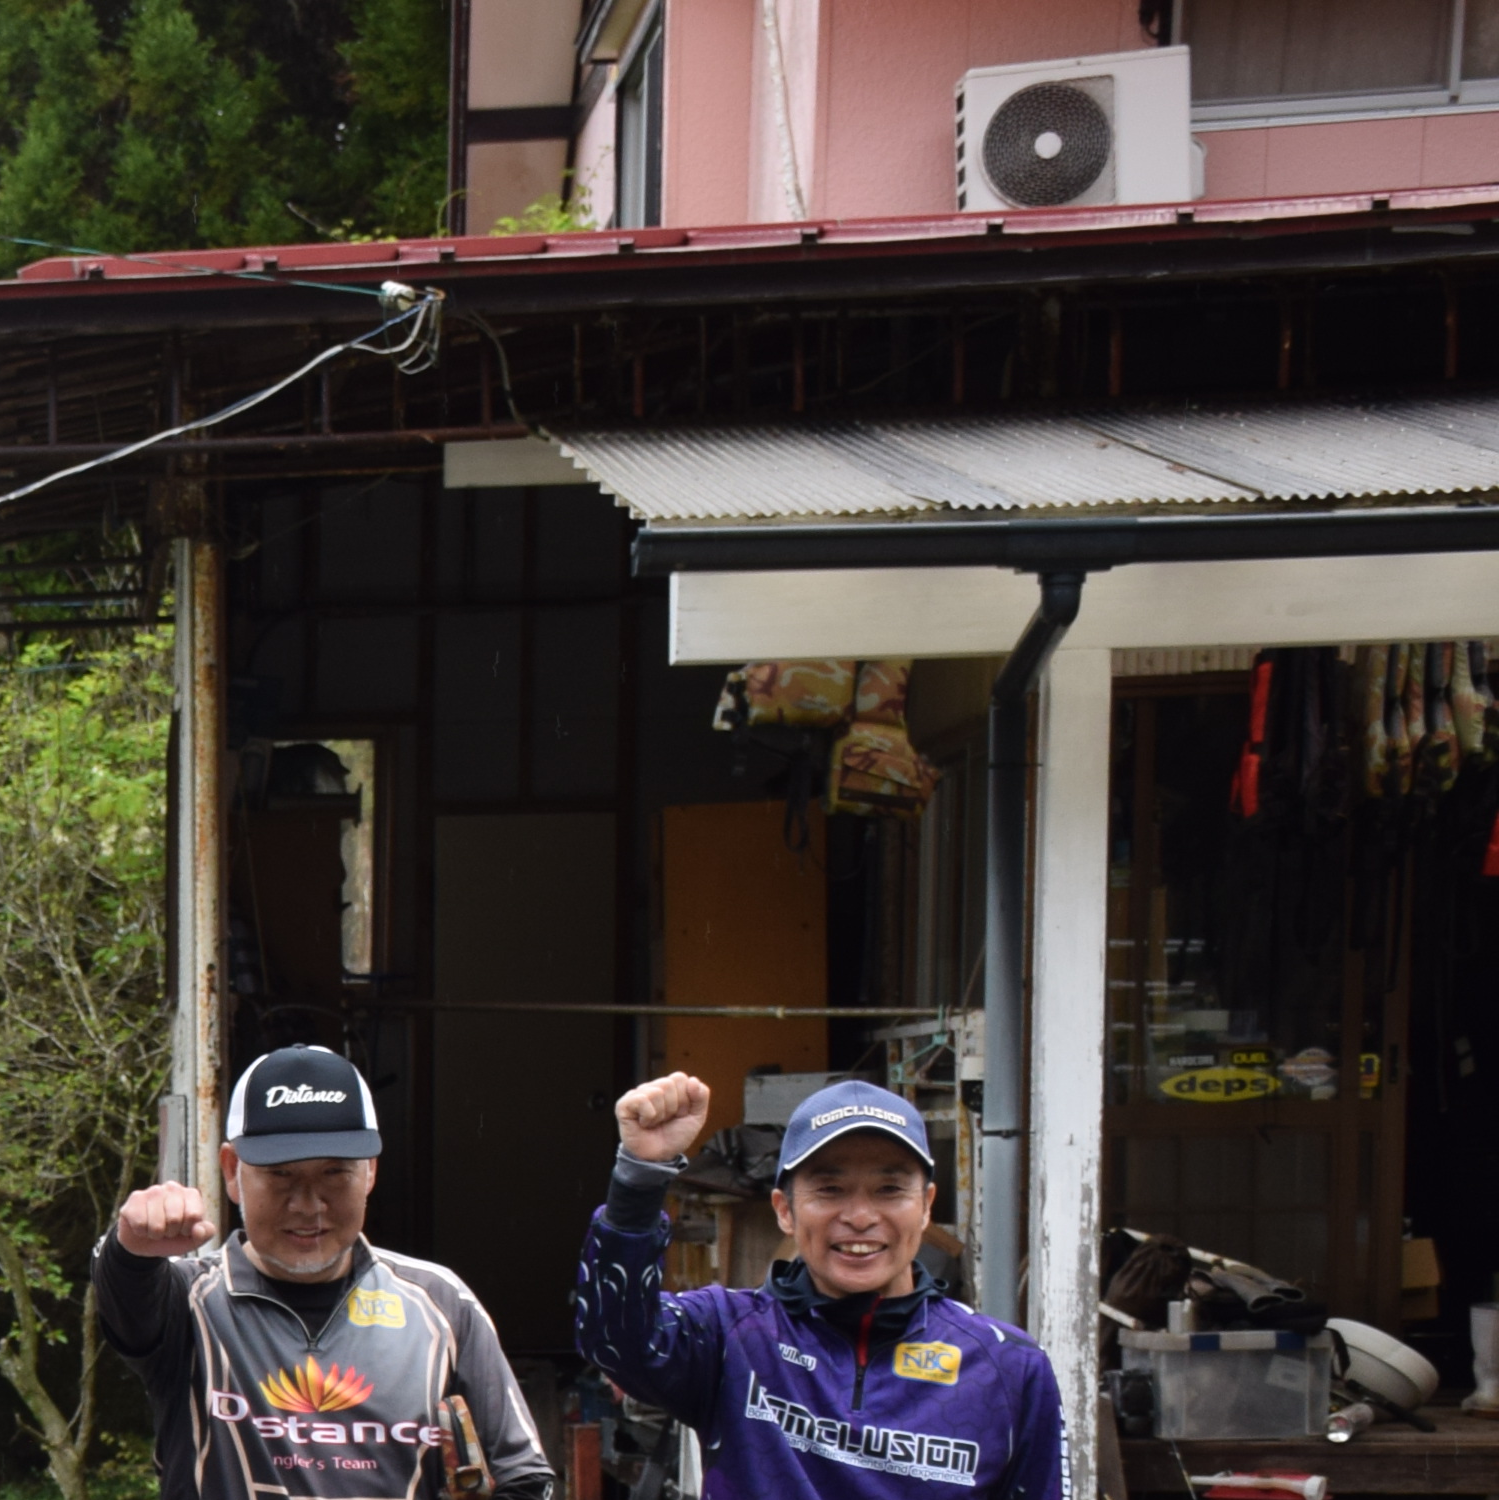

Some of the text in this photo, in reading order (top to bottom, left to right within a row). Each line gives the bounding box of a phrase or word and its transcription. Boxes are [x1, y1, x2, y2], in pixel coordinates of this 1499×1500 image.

[265, 1084, 347, 1109] Distance
[1174, 1077, 1269, 1097] deps
[903, 1349, 953, 1373] NBC
[211, 1390, 441, 1447] Dstance
[274, 1453, 377, 1471] ngler's Team
[887, 1460, 909, 1475] and
